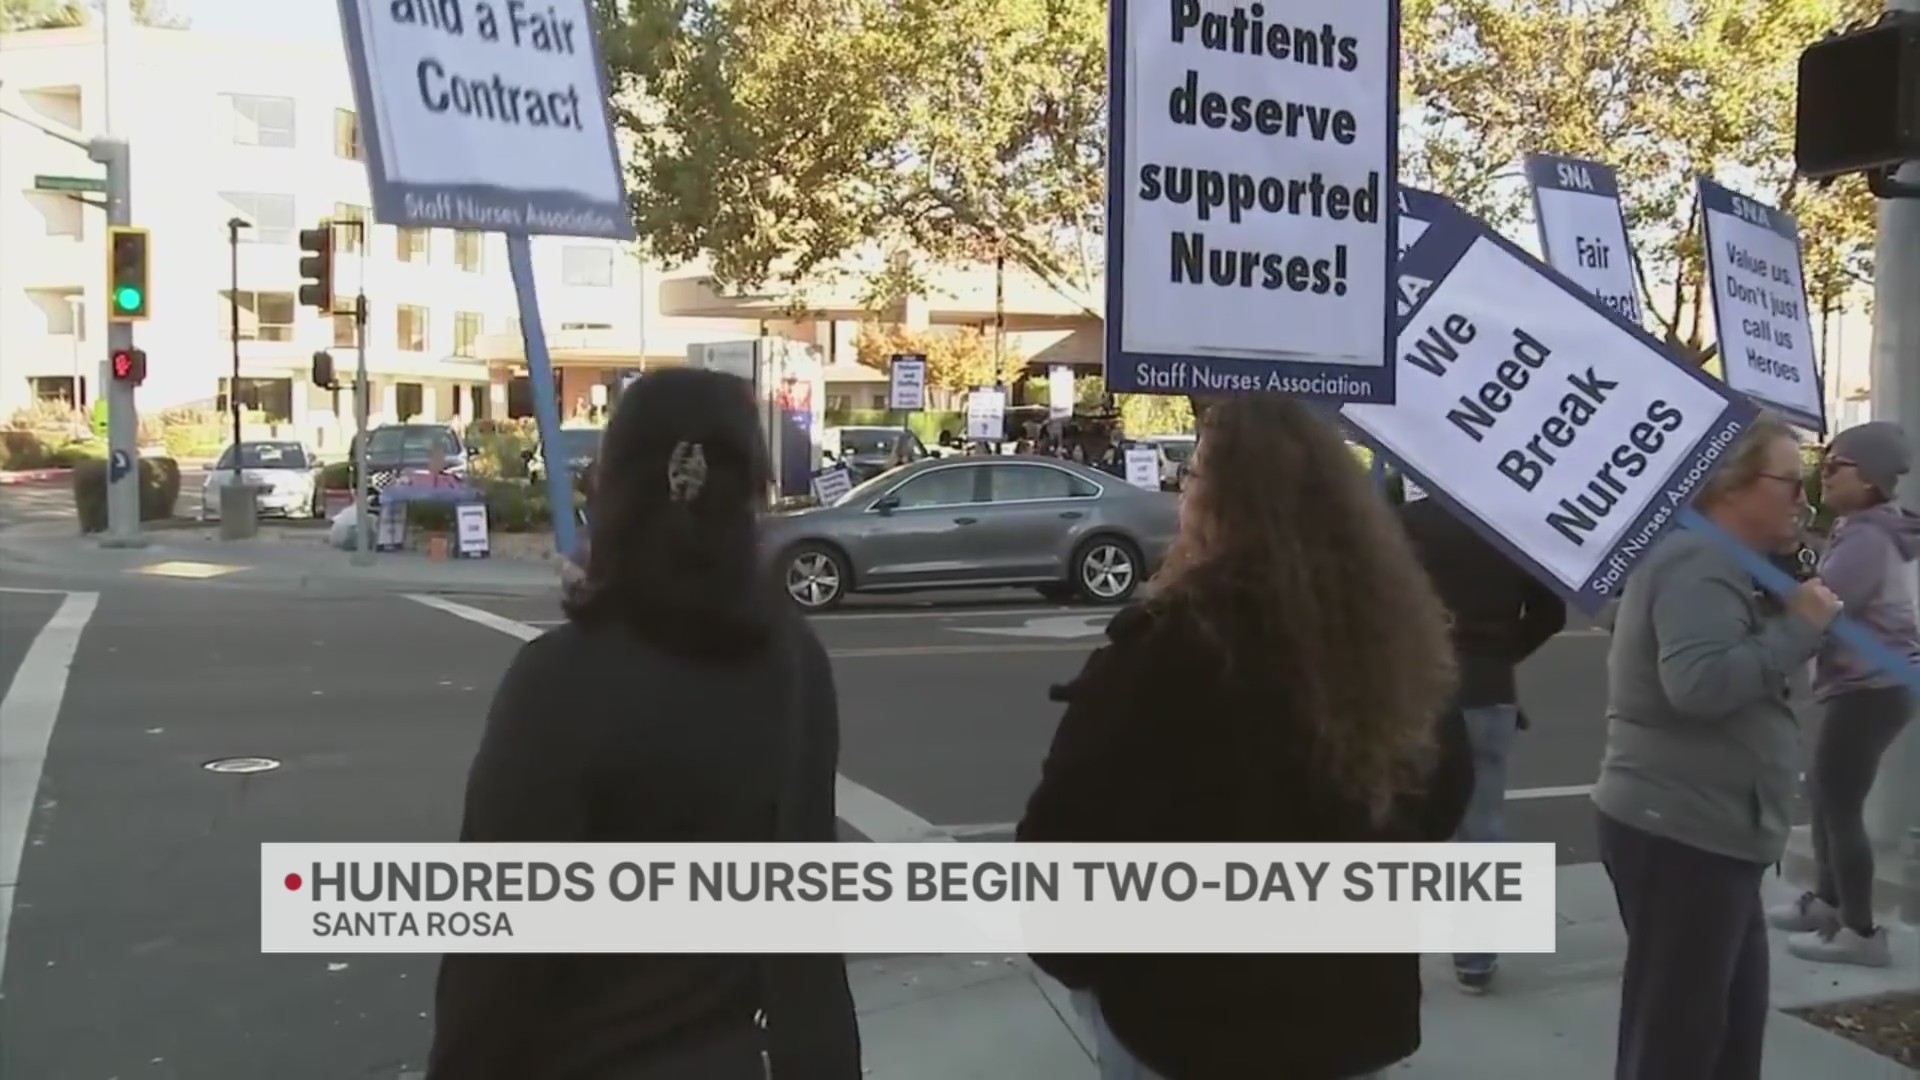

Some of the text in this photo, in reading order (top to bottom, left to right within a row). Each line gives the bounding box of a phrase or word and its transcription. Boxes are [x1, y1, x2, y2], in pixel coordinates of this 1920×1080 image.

[475, 1, 498, 42] a
[506, 0, 575, 55] Fair
[1170, 0, 1359, 72] Patients
[416, 57, 583, 131] Contract
[1169, 69, 1356, 145] deserve
[1139, 163, 1379, 224] supported
[1556, 163, 1594, 191] SNA
[404, 192, 616, 231] Staff Nurses Association
[1731, 197, 1771, 228] SNA
[1170, 231, 1347, 297] Nurses!
[1575, 236, 1610, 269] Fair
[1726, 240, 1767, 277] Value
[1726, 274, 1799, 321] Don't just
[1403, 312, 1477, 378] We
[1742, 317, 1794, 350] call us
[1136, 362, 1371, 396] Staff Nurses Association
[1445, 327, 1552, 444] Need
[1746, 347, 1801, 383] Heroes
[1496, 365, 1620, 493] Break
[1545, 398, 1684, 547] Nurses
[1591, 419, 1742, 596] Staff Nurses Association
